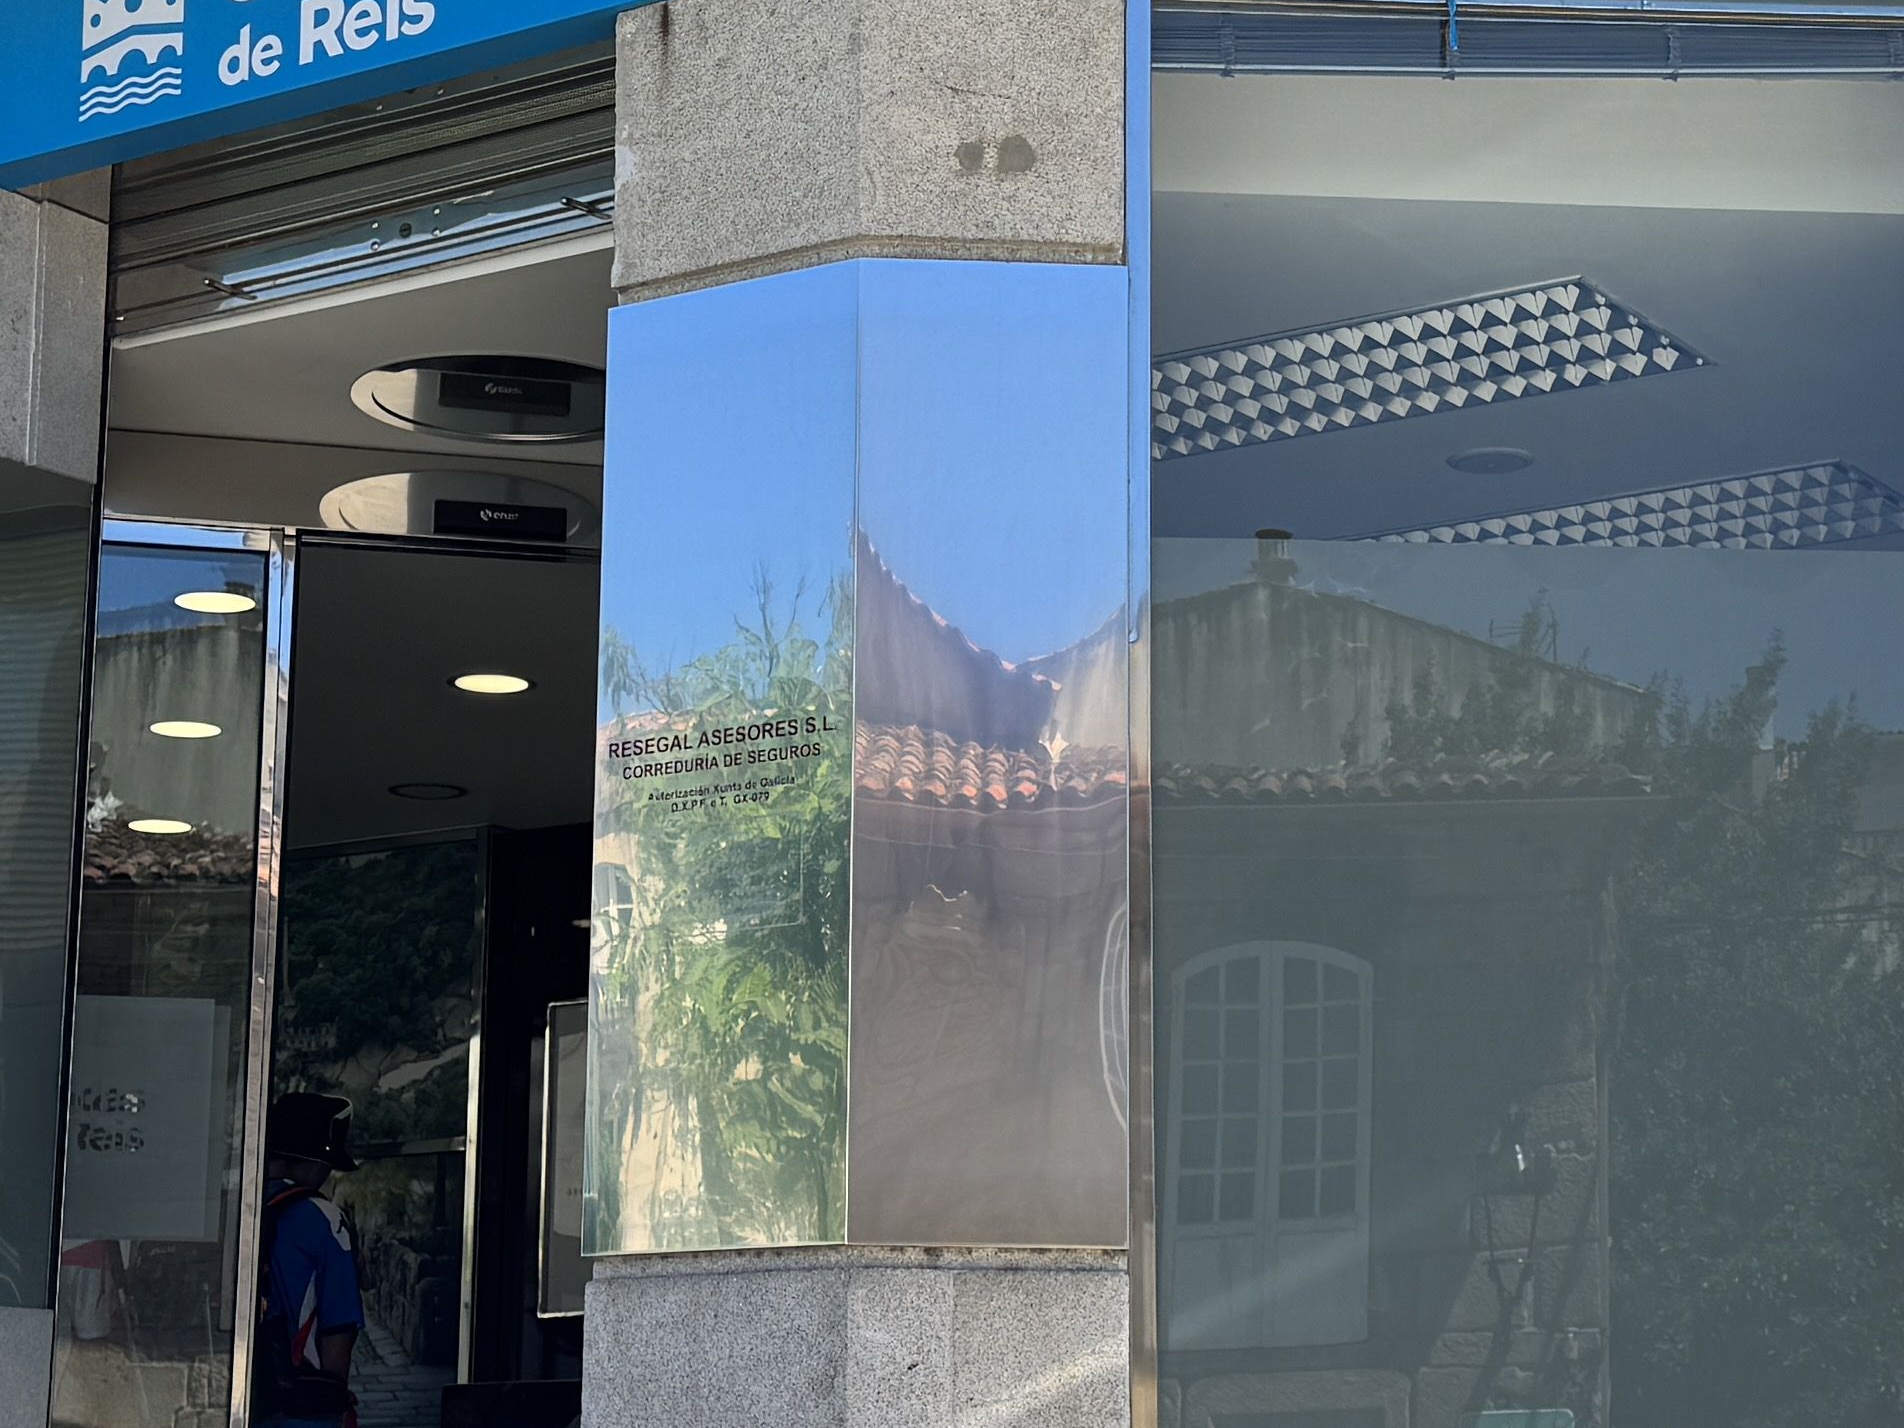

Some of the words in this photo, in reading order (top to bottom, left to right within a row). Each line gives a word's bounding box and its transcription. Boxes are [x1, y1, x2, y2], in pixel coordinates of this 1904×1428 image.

[218, 23, 283, 86] de
[609, 734, 693, 759] RESEGAL
[697, 719, 799, 748] ASESORES
[623, 753, 719, 780] CORREDURÍA
[724, 753, 742, 767] DE
[748, 742, 821, 764] SEGUROS
[714, 783, 742, 794] Xunta
[744, 780, 757, 791] de
